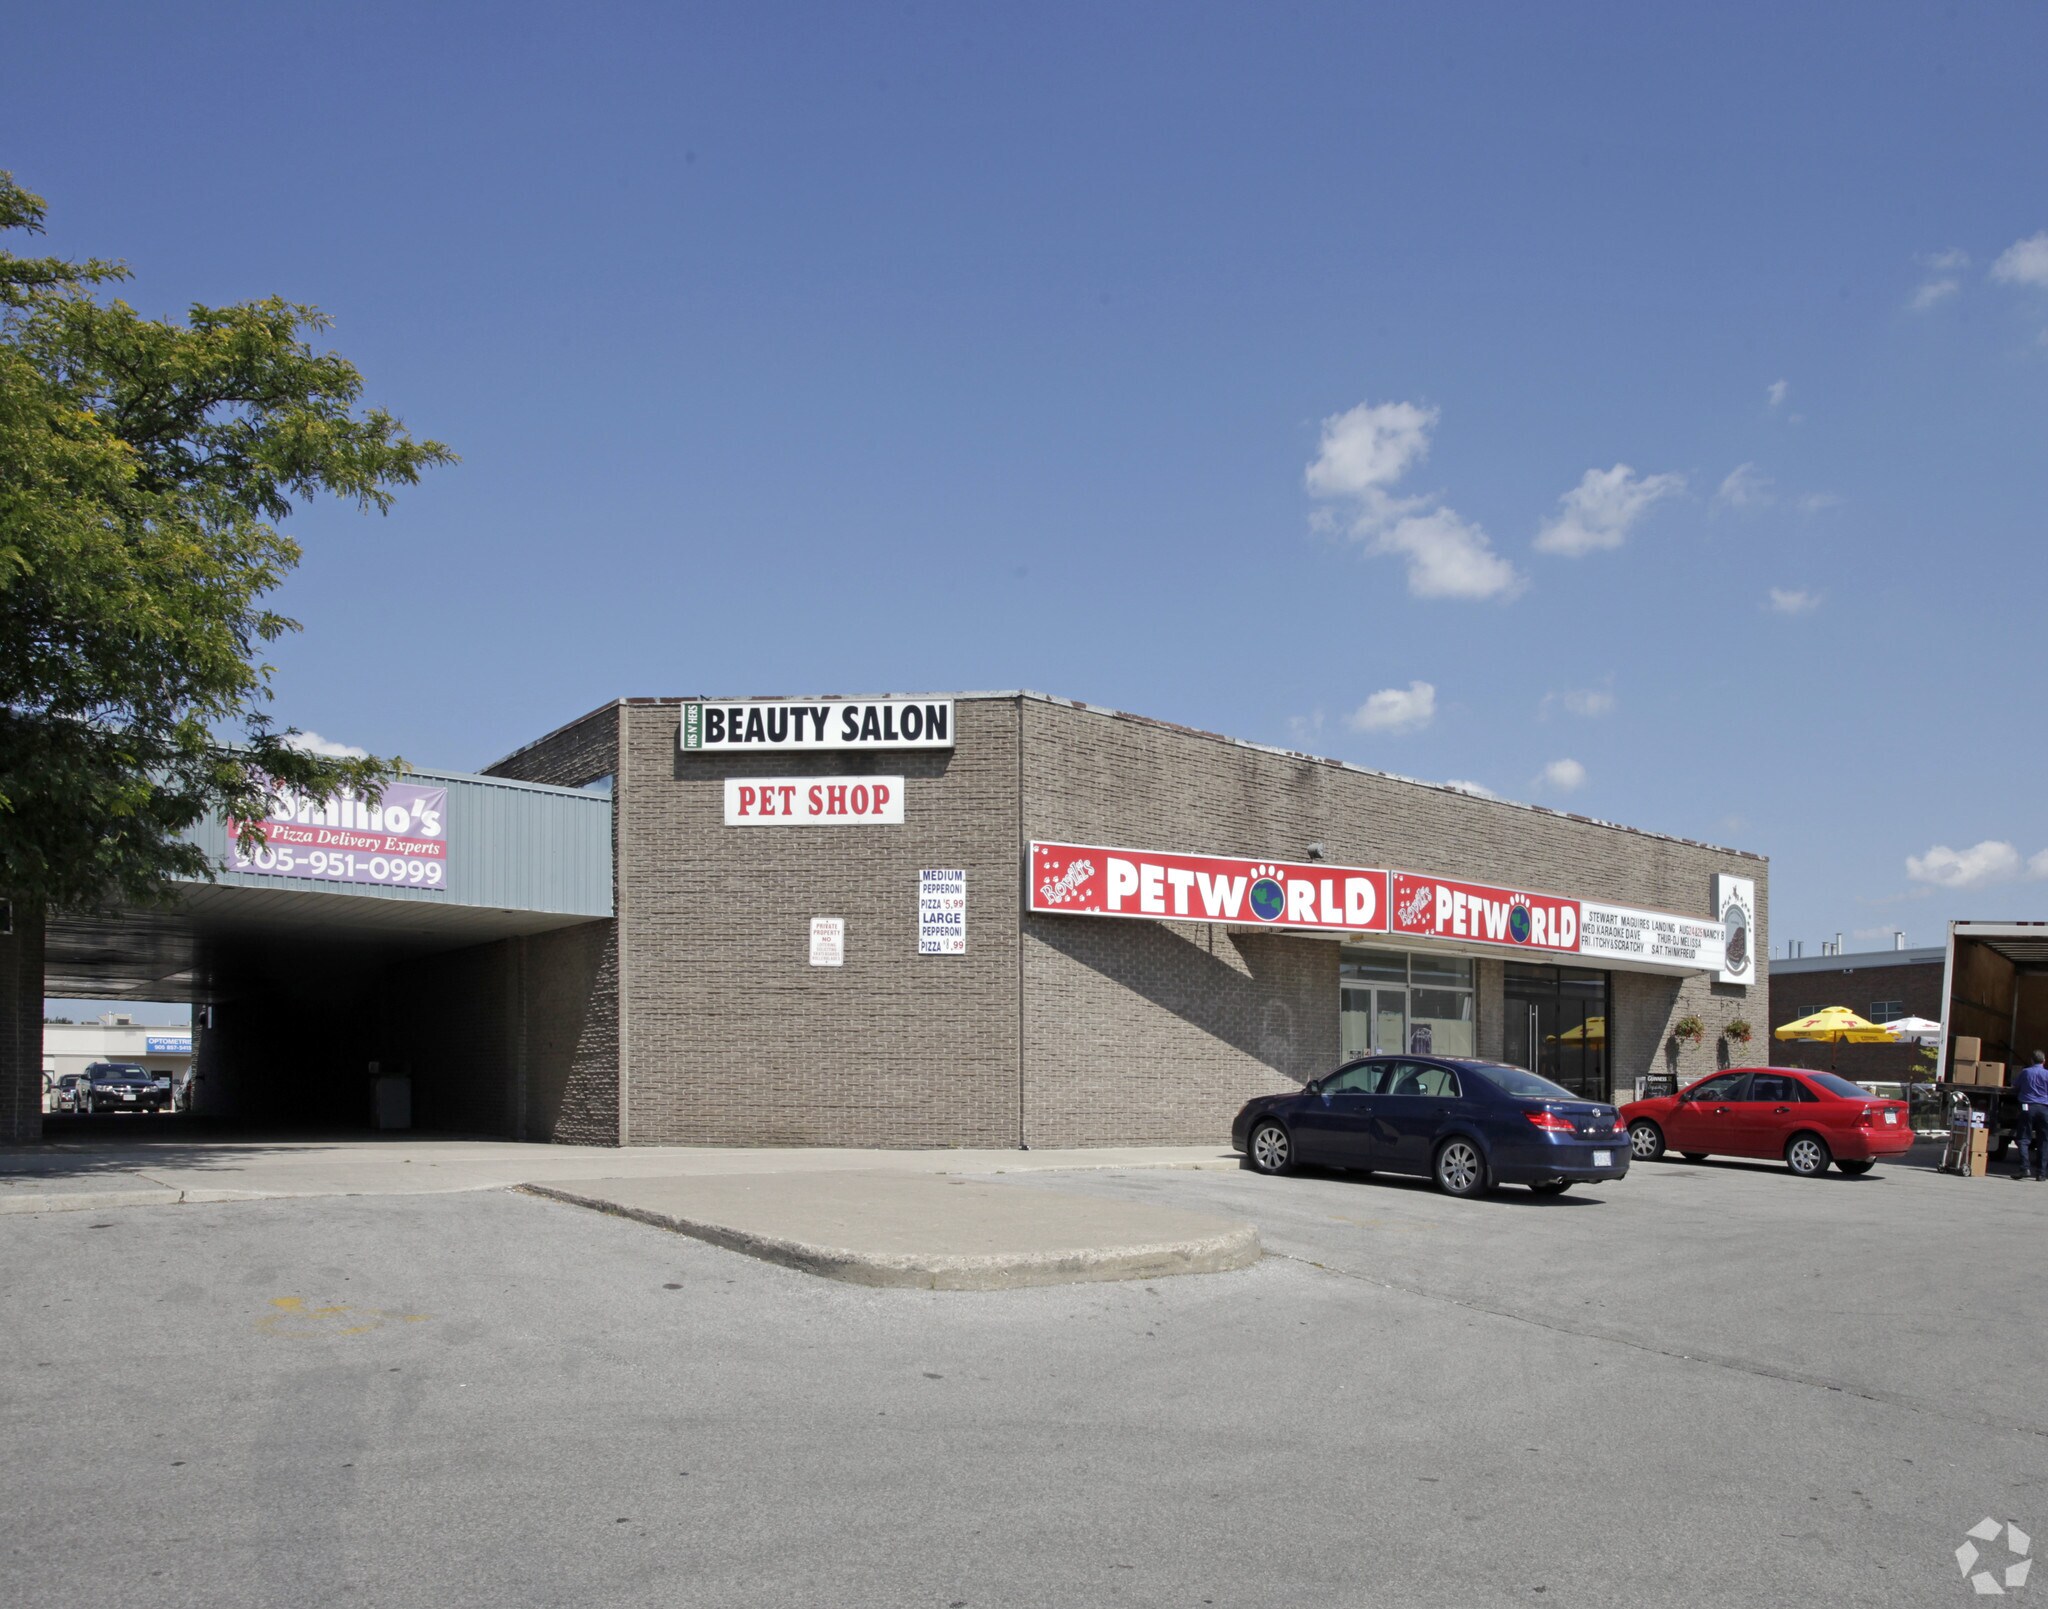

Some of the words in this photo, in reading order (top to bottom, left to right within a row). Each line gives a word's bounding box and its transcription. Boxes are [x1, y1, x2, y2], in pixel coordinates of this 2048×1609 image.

[687, 704, 698, 724] HERS
[705, 706, 831, 743] BEAUTY
[841, 704, 948, 741] SALON
[687, 734, 698, 747] HIS
[237, 780, 442, 838] omino's
[737, 786, 796, 816] PET
[808, 784, 890, 815] SHOP
[271, 825, 313, 843] Pizza
[317, 829, 381, 852] Delivery
[384, 837, 440, 856] Experts
[234, 846, 443, 885] 905-951-0999
[922, 870, 963, 881] MEDIUM
[922, 883, 962, 894] PEPPERONI
[920, 899, 941, 910] PIZZA
[922, 912, 961, 924] LARGE
[1588, 911, 1619, 926] STEWART
[1651, 921, 1676, 934] LANDING
[922, 926, 962, 937] PEPPERONI
[1596, 925, 1625, 940] KARAOKE
[1625, 930, 1641, 941] DAVE
[1679, 936, 1702, 948] MELISSA
[920, 941, 941, 952] PIZZA
